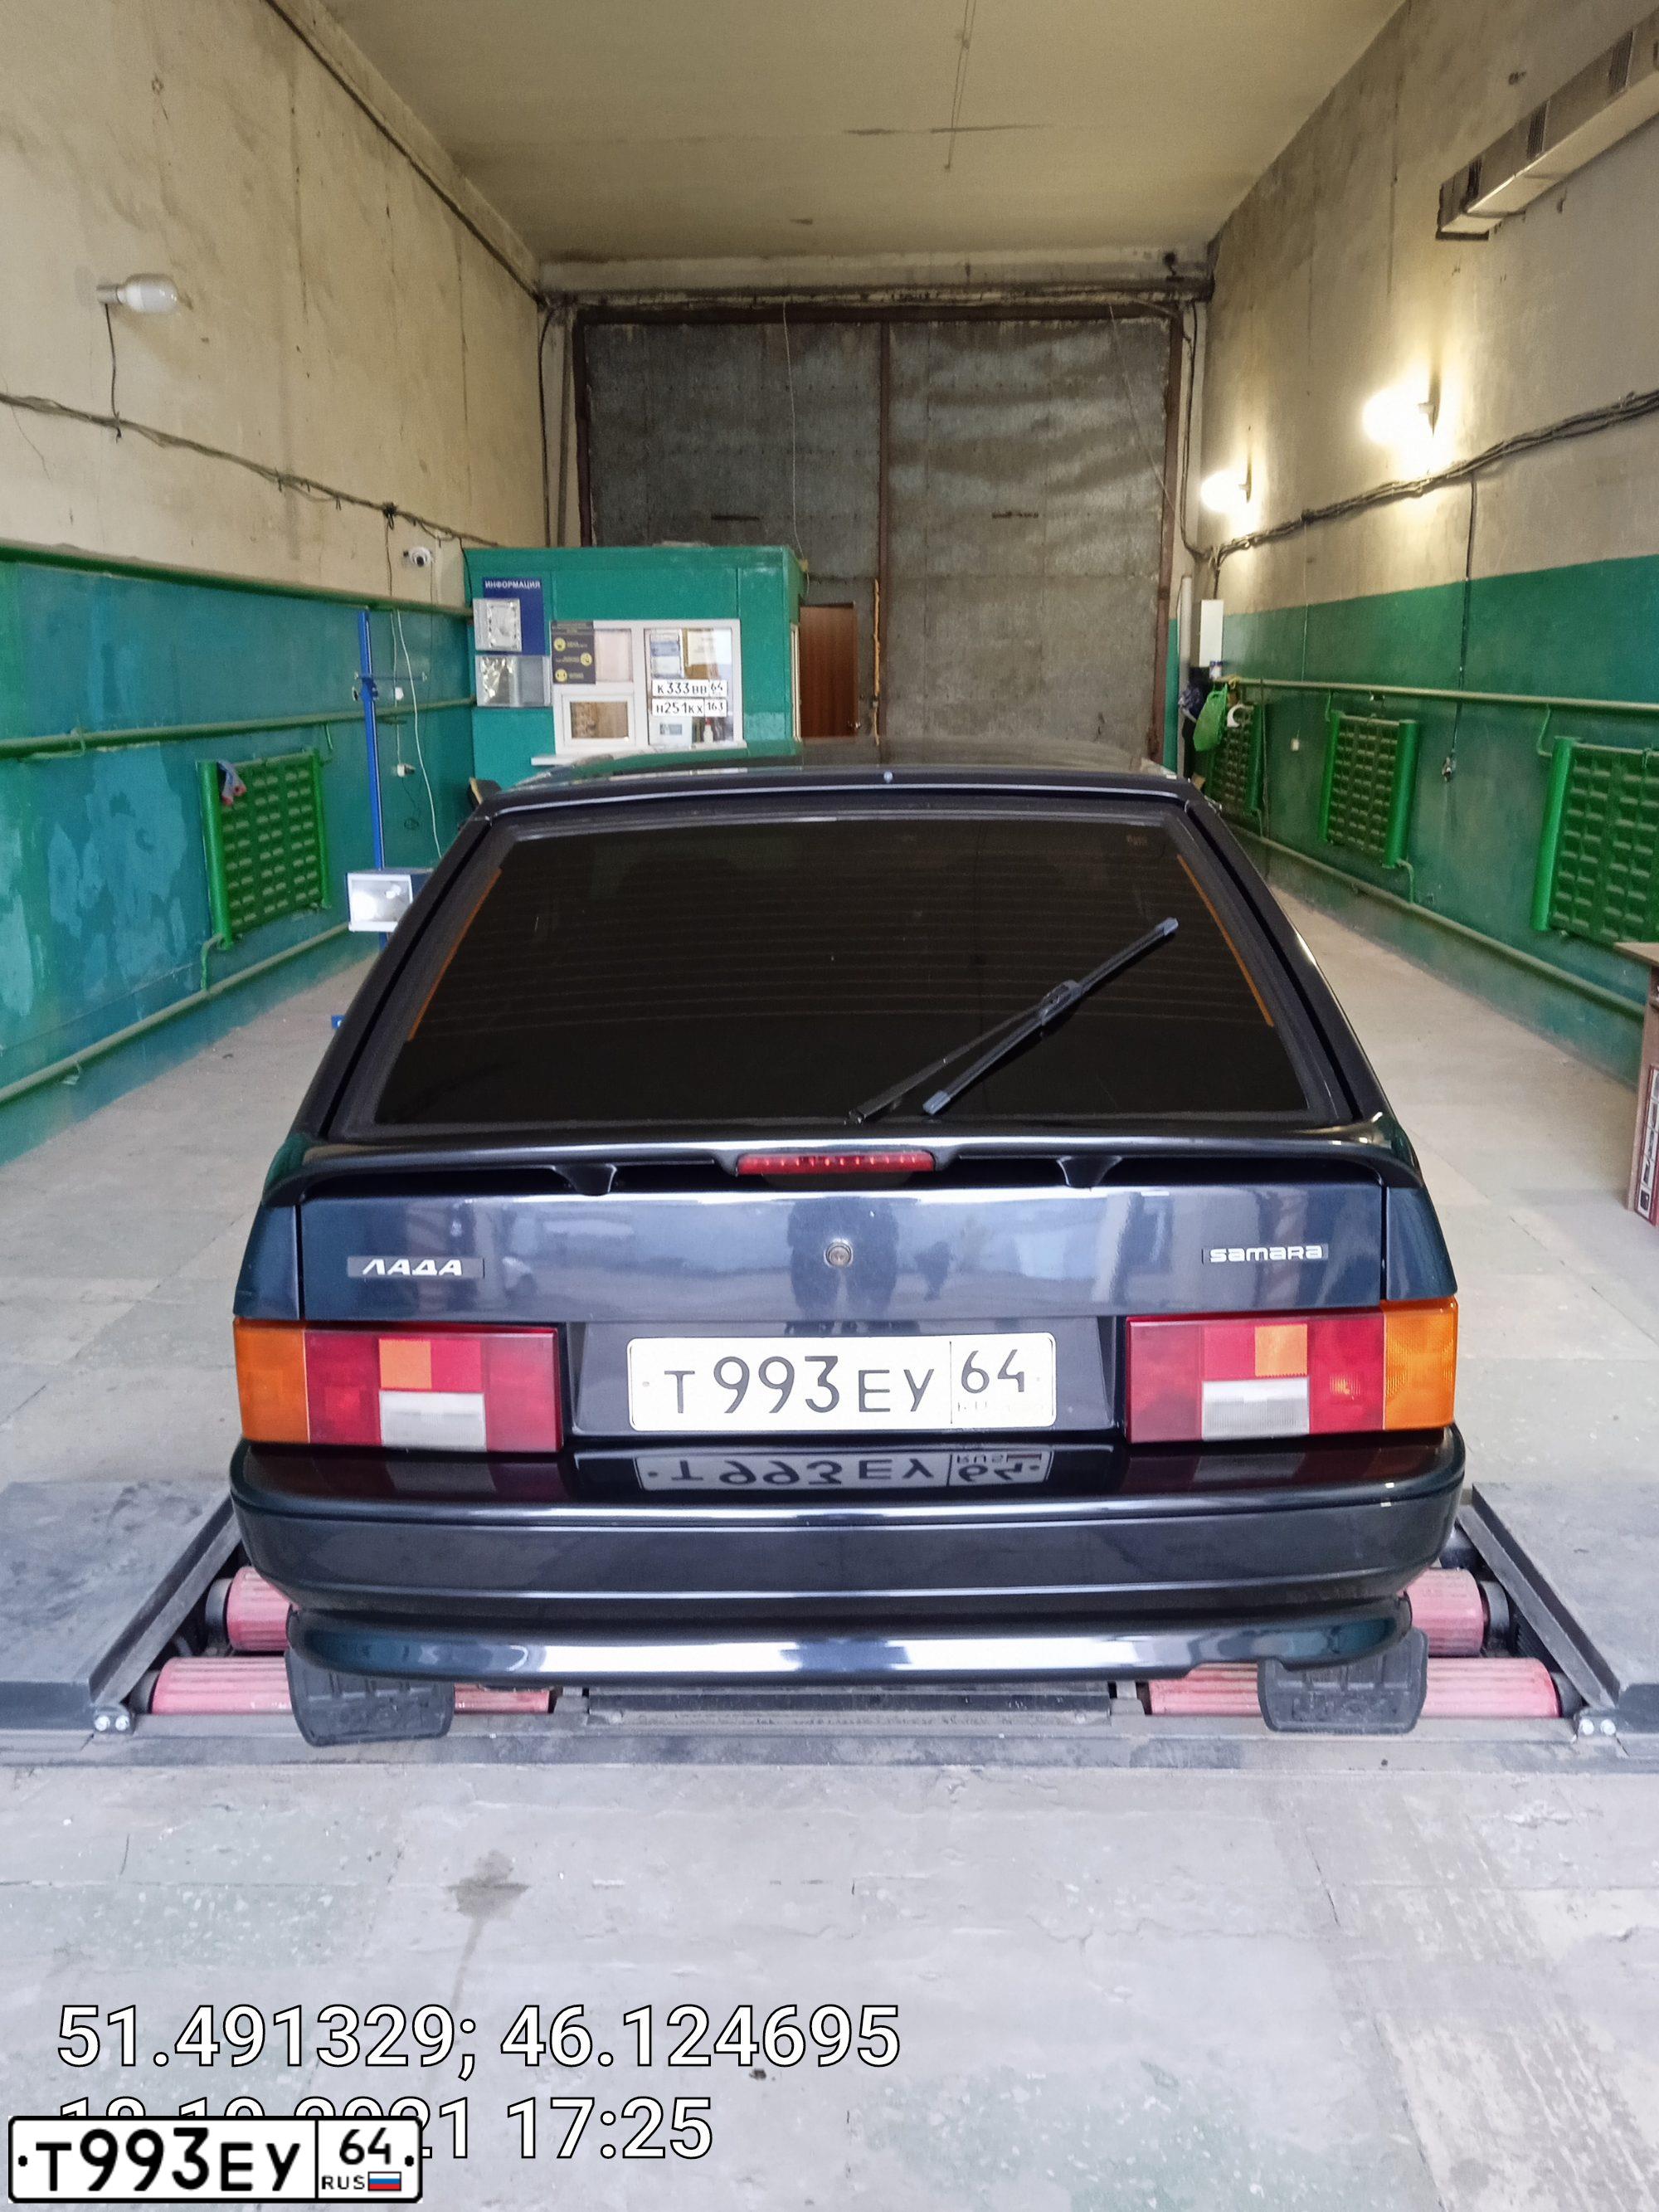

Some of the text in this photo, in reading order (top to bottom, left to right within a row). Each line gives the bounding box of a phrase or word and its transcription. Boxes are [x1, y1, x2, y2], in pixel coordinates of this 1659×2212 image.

[484, 580, 541, 590] ИНФОРМАЦИЯ
[362, 1258, 463, 1277] ЛАДА
[961, 1348, 1025, 1394] 64
